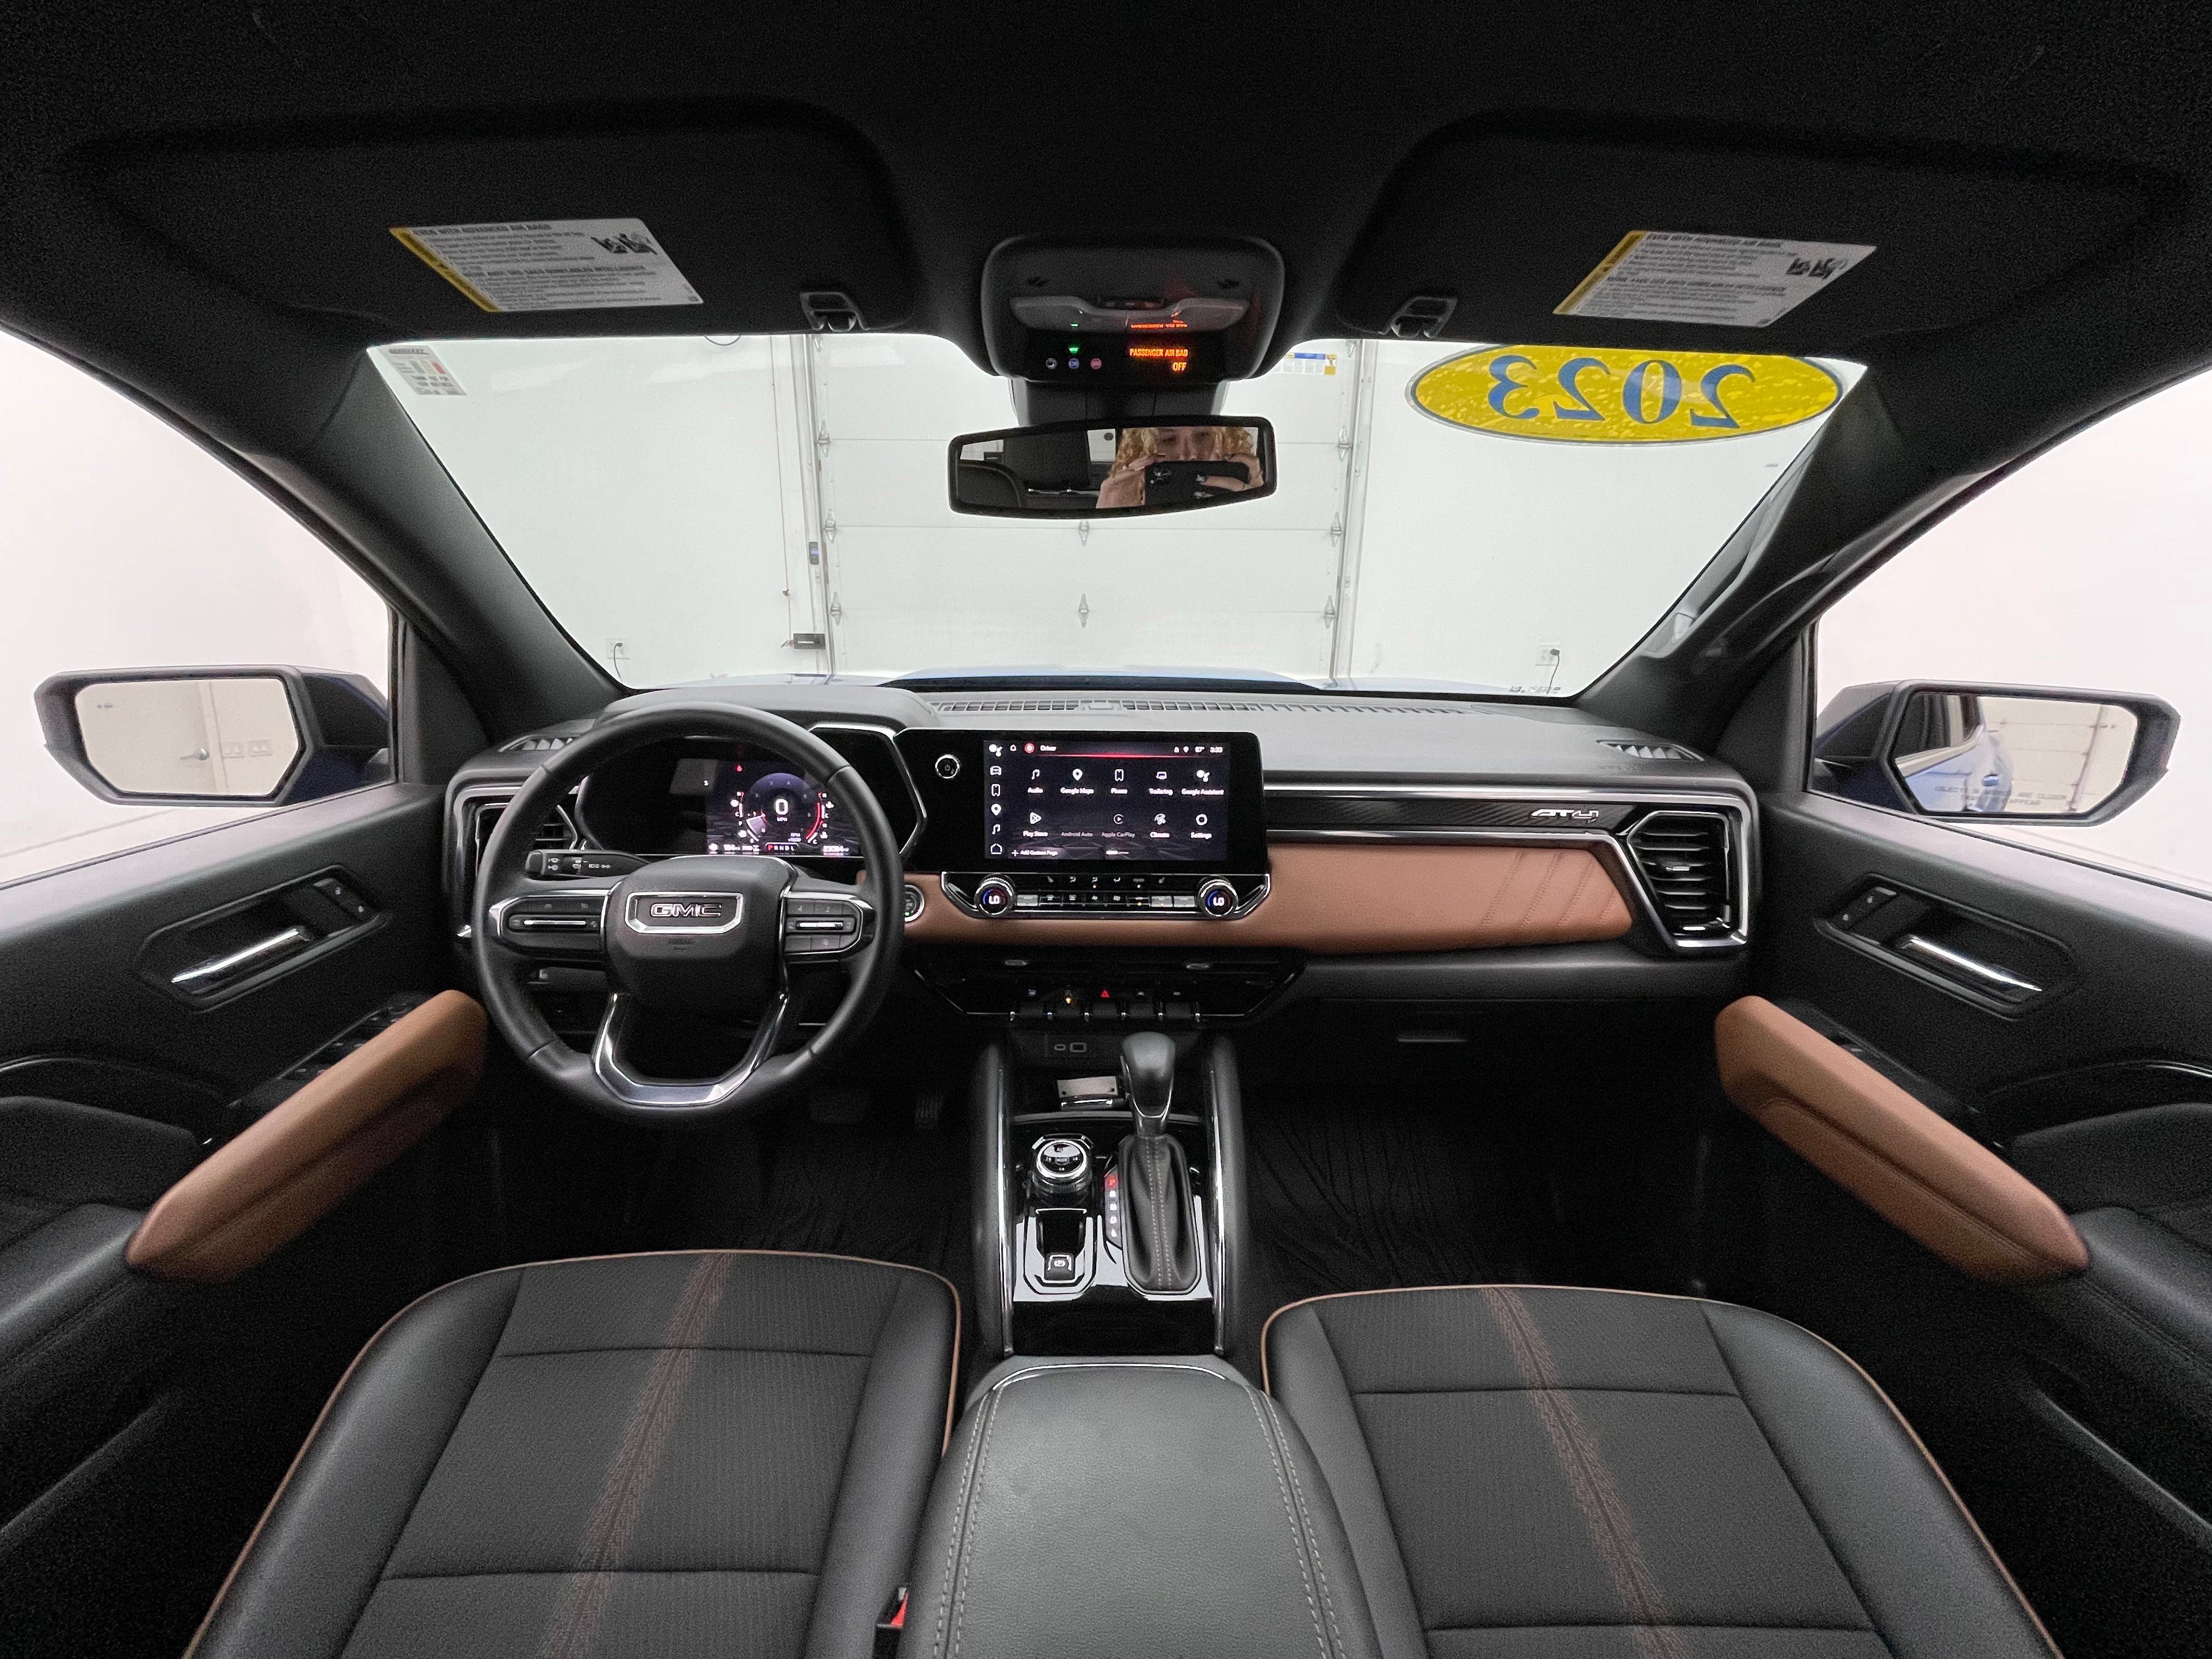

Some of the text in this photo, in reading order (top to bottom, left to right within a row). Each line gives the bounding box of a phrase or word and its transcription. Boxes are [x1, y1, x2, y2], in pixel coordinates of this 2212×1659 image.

[1129, 348, 1188, 357] PASSENGER AIR BAG
[1172, 362, 1187, 371] OFF
[1060, 787, 1079, 795] Google
[1181, 788, 1200, 796] Google
[775, 798, 789, 815] 0
[651, 903, 722, 917] GMC
